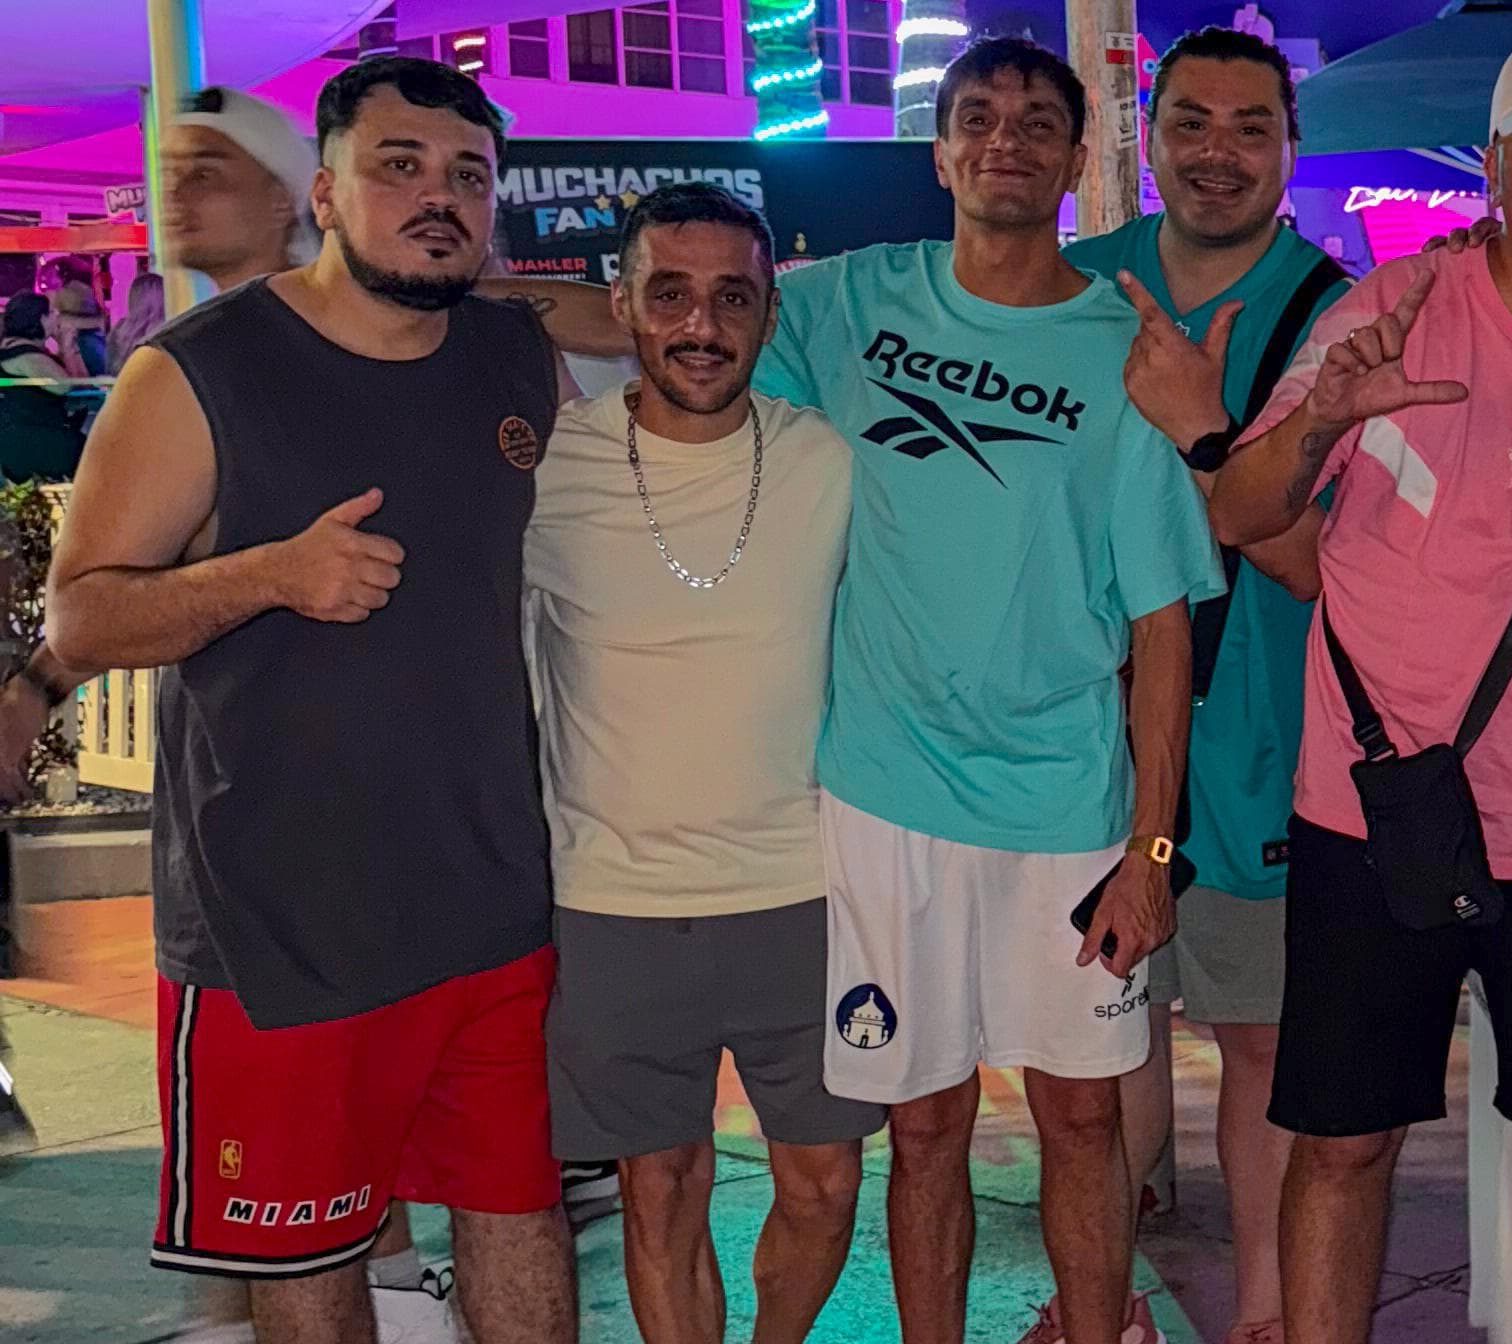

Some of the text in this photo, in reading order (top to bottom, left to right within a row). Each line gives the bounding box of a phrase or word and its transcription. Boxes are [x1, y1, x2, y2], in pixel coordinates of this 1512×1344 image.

[534, 207, 616, 237] FAN
[506, 257, 588, 272] MAHLER
[862, 329, 1087, 431] Reebok
[223, 1184, 371, 1226] MIAMI
